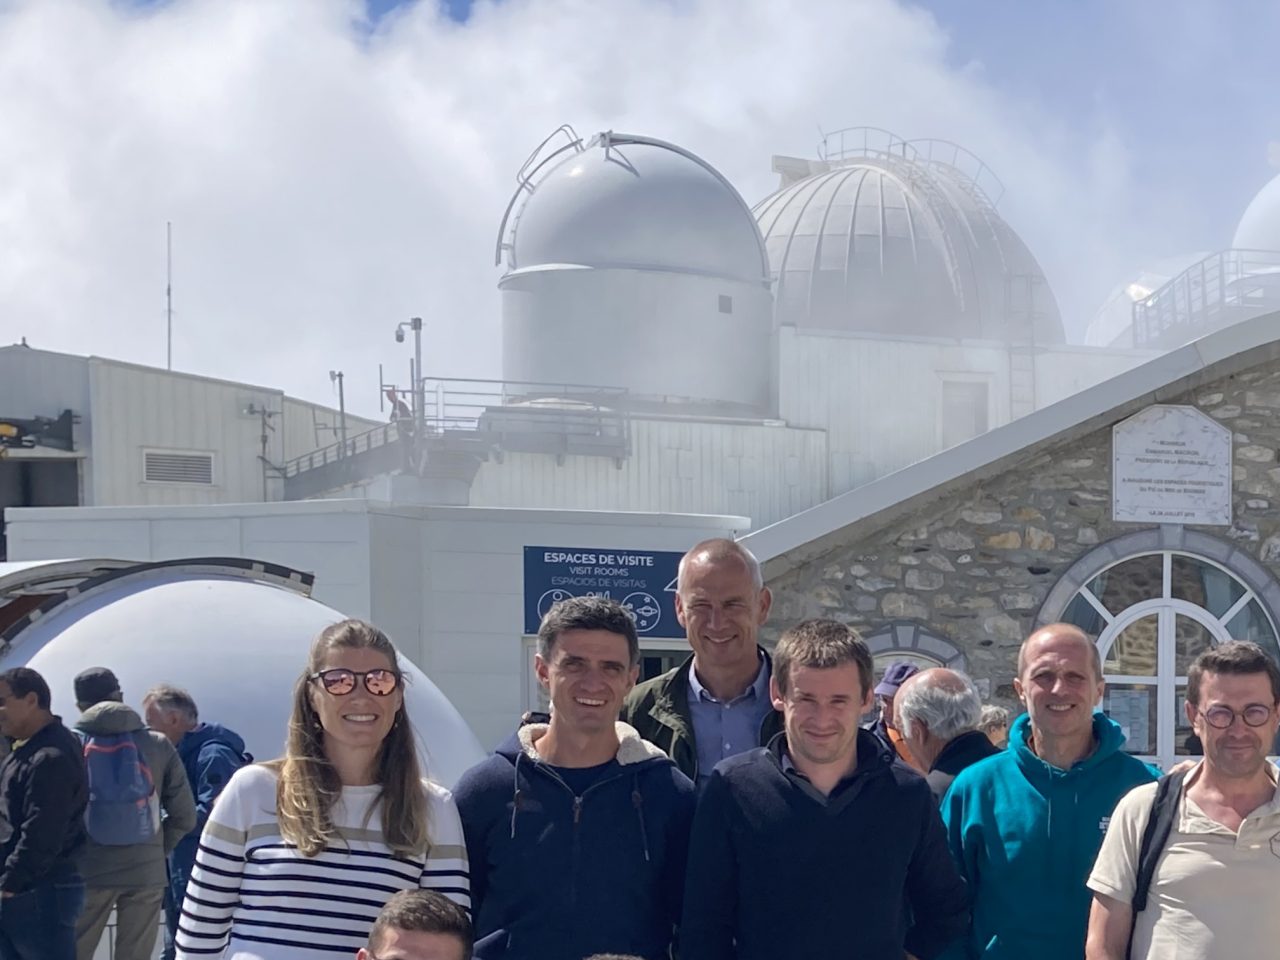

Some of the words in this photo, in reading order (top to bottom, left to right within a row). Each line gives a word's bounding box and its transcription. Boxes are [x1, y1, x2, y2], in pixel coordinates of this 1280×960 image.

[544, 552, 596, 564] ESPACES
[599, 554, 615, 565] DE
[616, 555, 654, 566] VISITE
[569, 566, 592, 575] VISIT
[594, 567, 629, 576] ROOMS
[551, 576, 596, 586] ESPACIOS
[598, 577, 611, 587] DE
[613, 578, 647, 588] VISITAS
